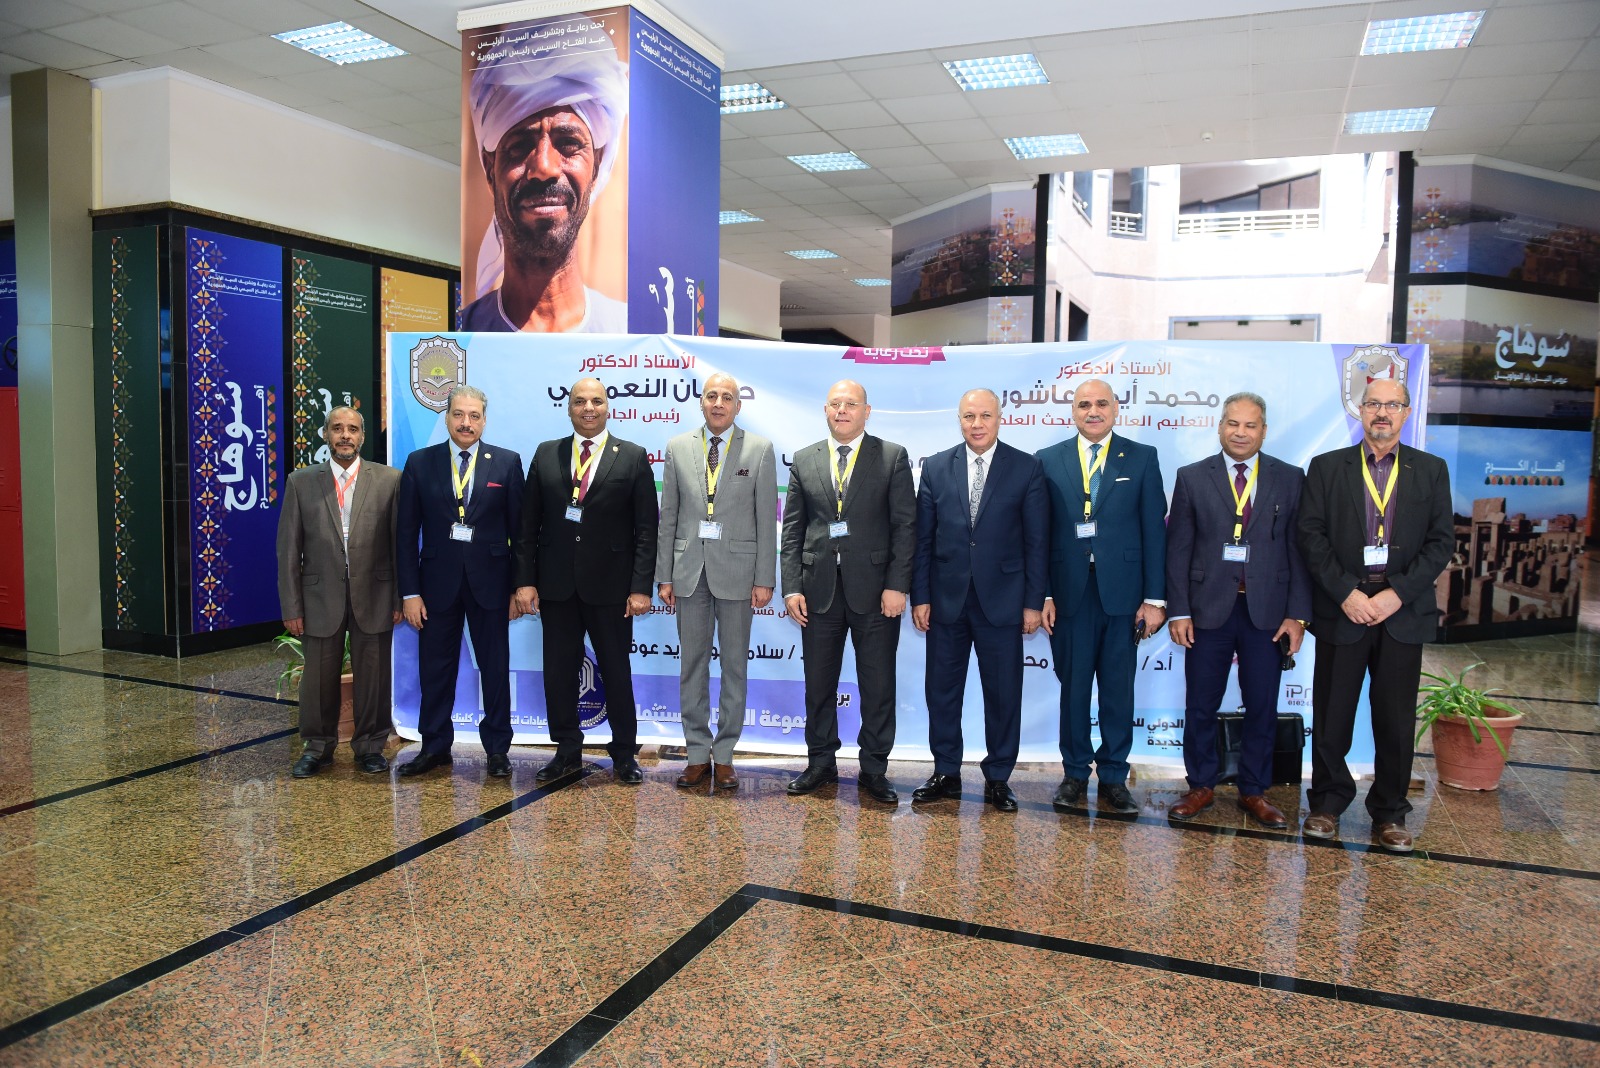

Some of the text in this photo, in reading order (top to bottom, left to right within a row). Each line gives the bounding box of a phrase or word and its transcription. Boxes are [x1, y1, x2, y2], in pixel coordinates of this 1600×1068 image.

[478, 20, 605, 48] تحت رعاية وبتشريف السيد الرئيس
[476, 36, 606, 62] عبد الفتاح السيسي رئيس الجمهورية
[579, 352, 696, 372] الأستاذ الدكتور
[1056, 359, 1171, 379] الأستاذ الدكتور
[548, 378, 666, 407] النعمي
[1002, 380, 1074, 408] عاشور
[1145, 390, 1220, 408] محمد
[607, 408, 680, 424] رئيس الجا
[1114, 415, 1151, 427] العال
[1157, 416, 1214, 430] التعليم
[748, 644, 784, 660] سلام
[1147, 736, 1184, 750] جديدة
